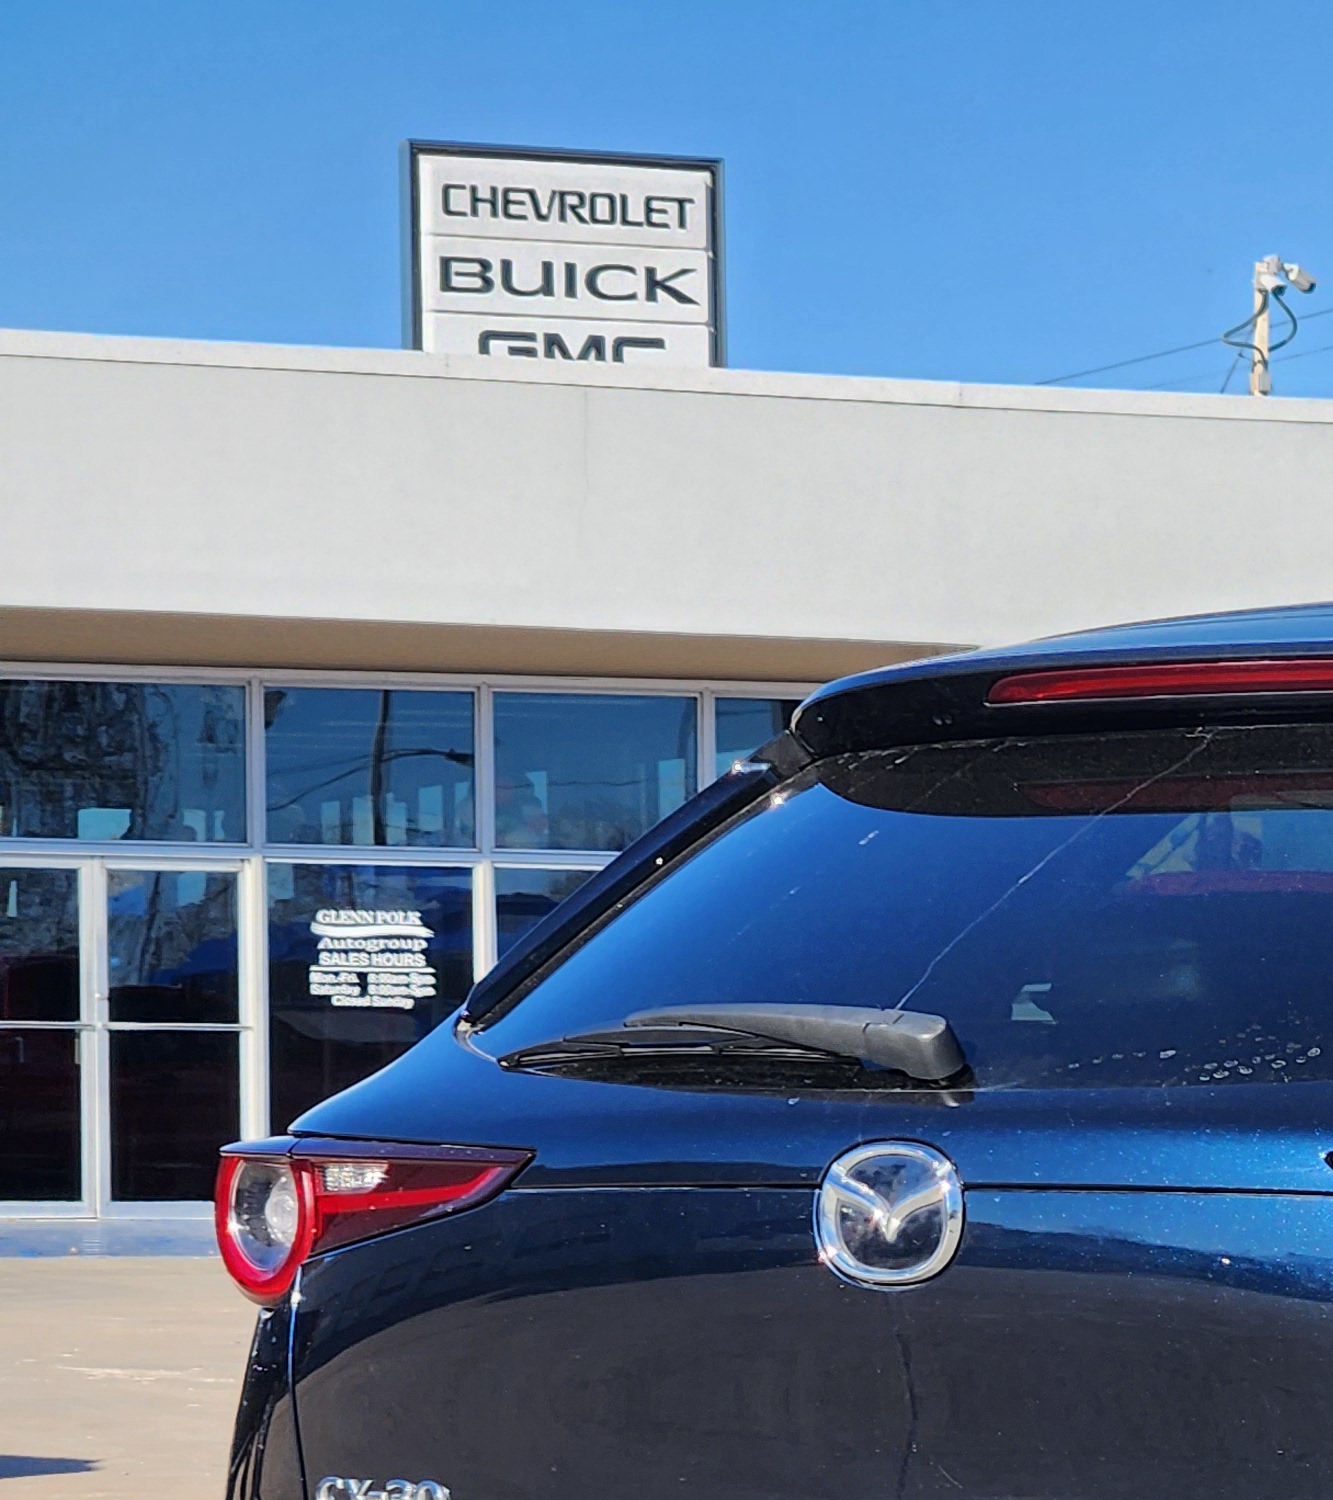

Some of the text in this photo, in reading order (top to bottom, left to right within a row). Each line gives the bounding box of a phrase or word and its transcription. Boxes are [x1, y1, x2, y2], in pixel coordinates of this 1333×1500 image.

[441, 182, 696, 230] CHEVROLET
[438, 255, 701, 307] BUICK
[315, 908, 423, 926] GLENN POLK
[317, 937, 428, 952] Autogroup
[318, 952, 427, 968] SALES HOURS
[309, 983, 362, 997] Saturday
[331, 995, 415, 1010] Closed Sunday
